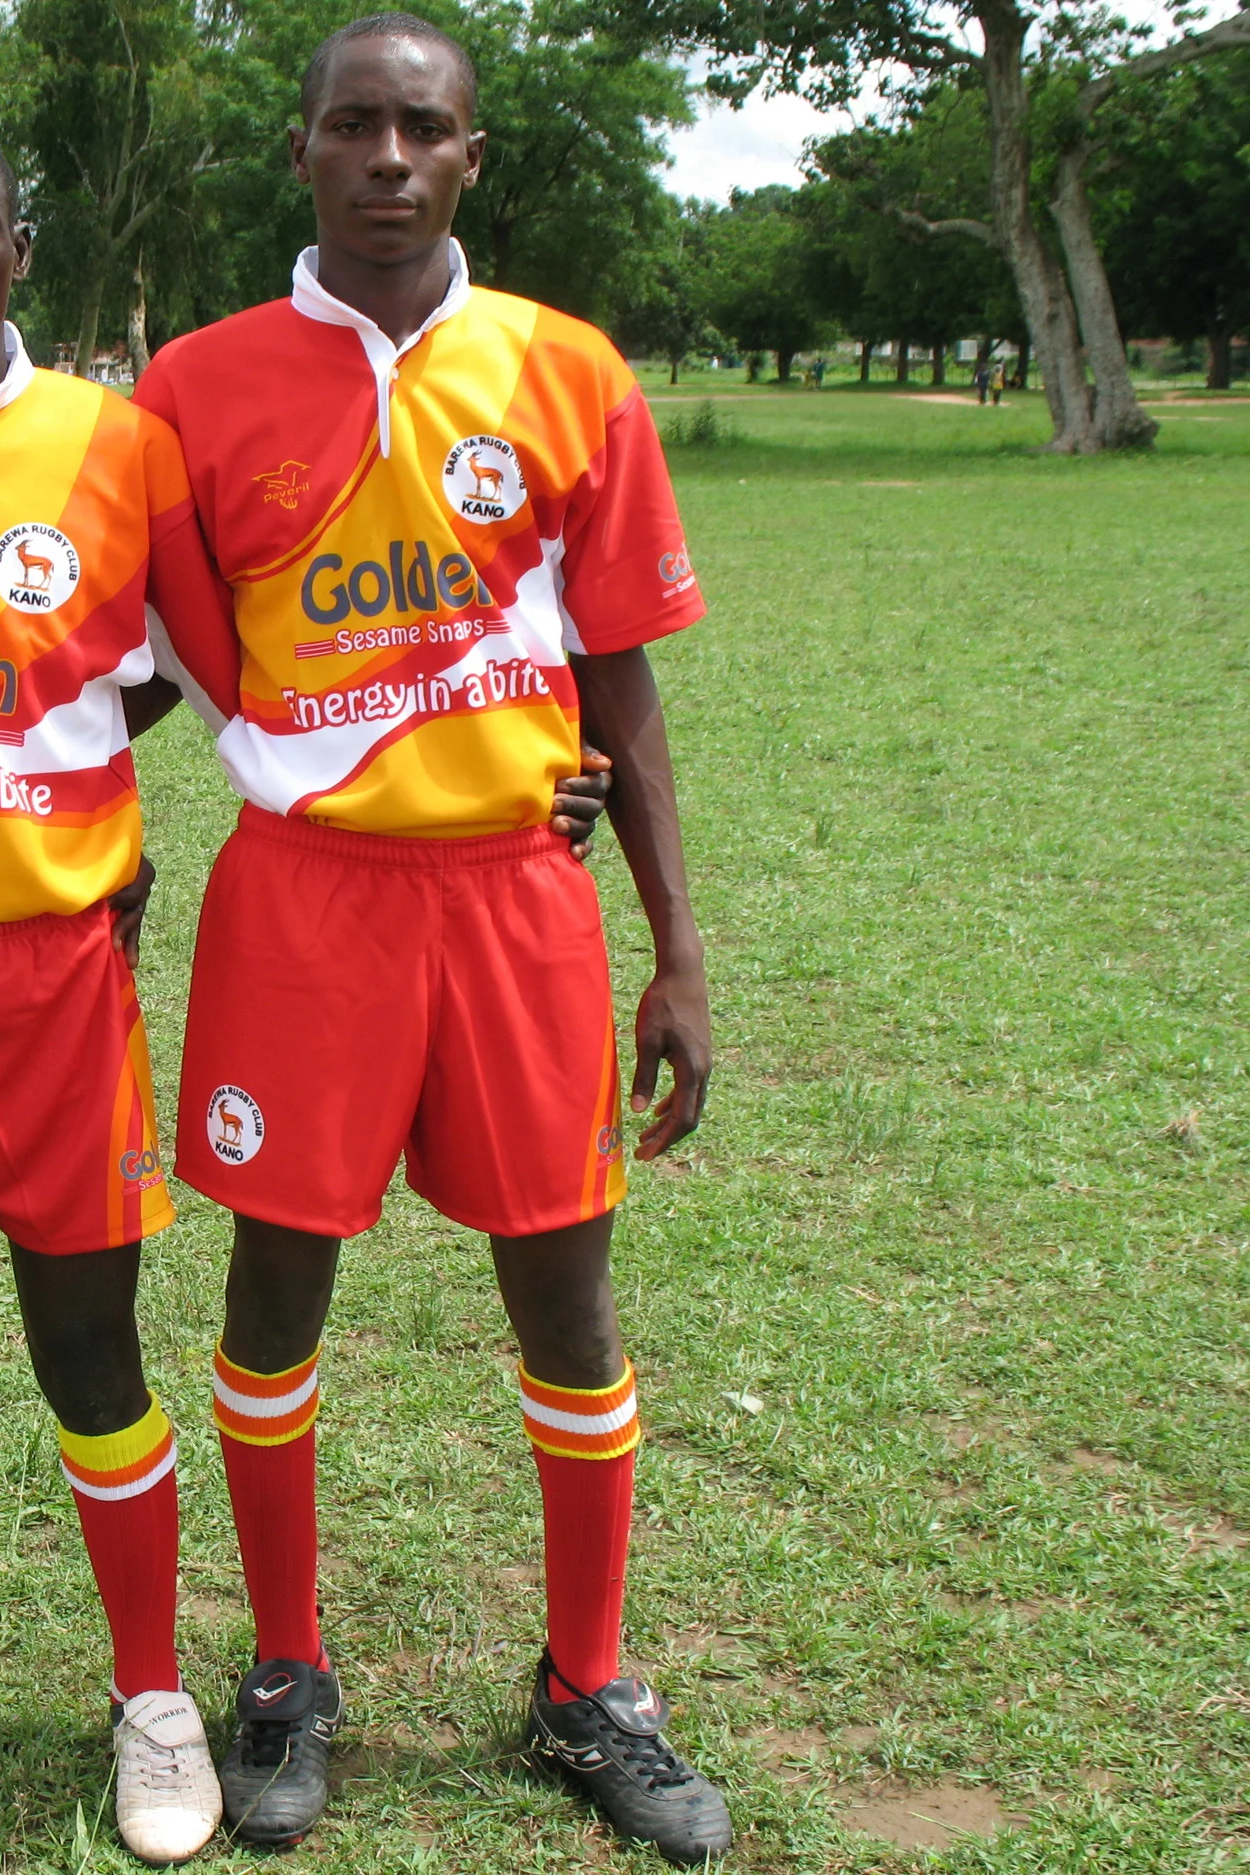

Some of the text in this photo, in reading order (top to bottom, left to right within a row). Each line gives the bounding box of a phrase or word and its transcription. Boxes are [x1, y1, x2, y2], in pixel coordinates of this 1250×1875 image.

[445, 438, 478, 475] BAREWA
[479, 436, 515, 458] RUGBY
[461, 501, 505, 518] KANO
[31, 525, 69, 547] RUGBY
[66, 550, 78, 581] CLUB
[9, 588, 51, 608] KANO
[337, 619, 484, 654] Sesame Snaps
[415, 673, 450, 712] in
[466, 677, 487, 708] a
[228, 1087, 255, 1107] RUGBY
[252, 1109, 263, 1137] CLUB
[216, 1141, 243, 1161] KANO
